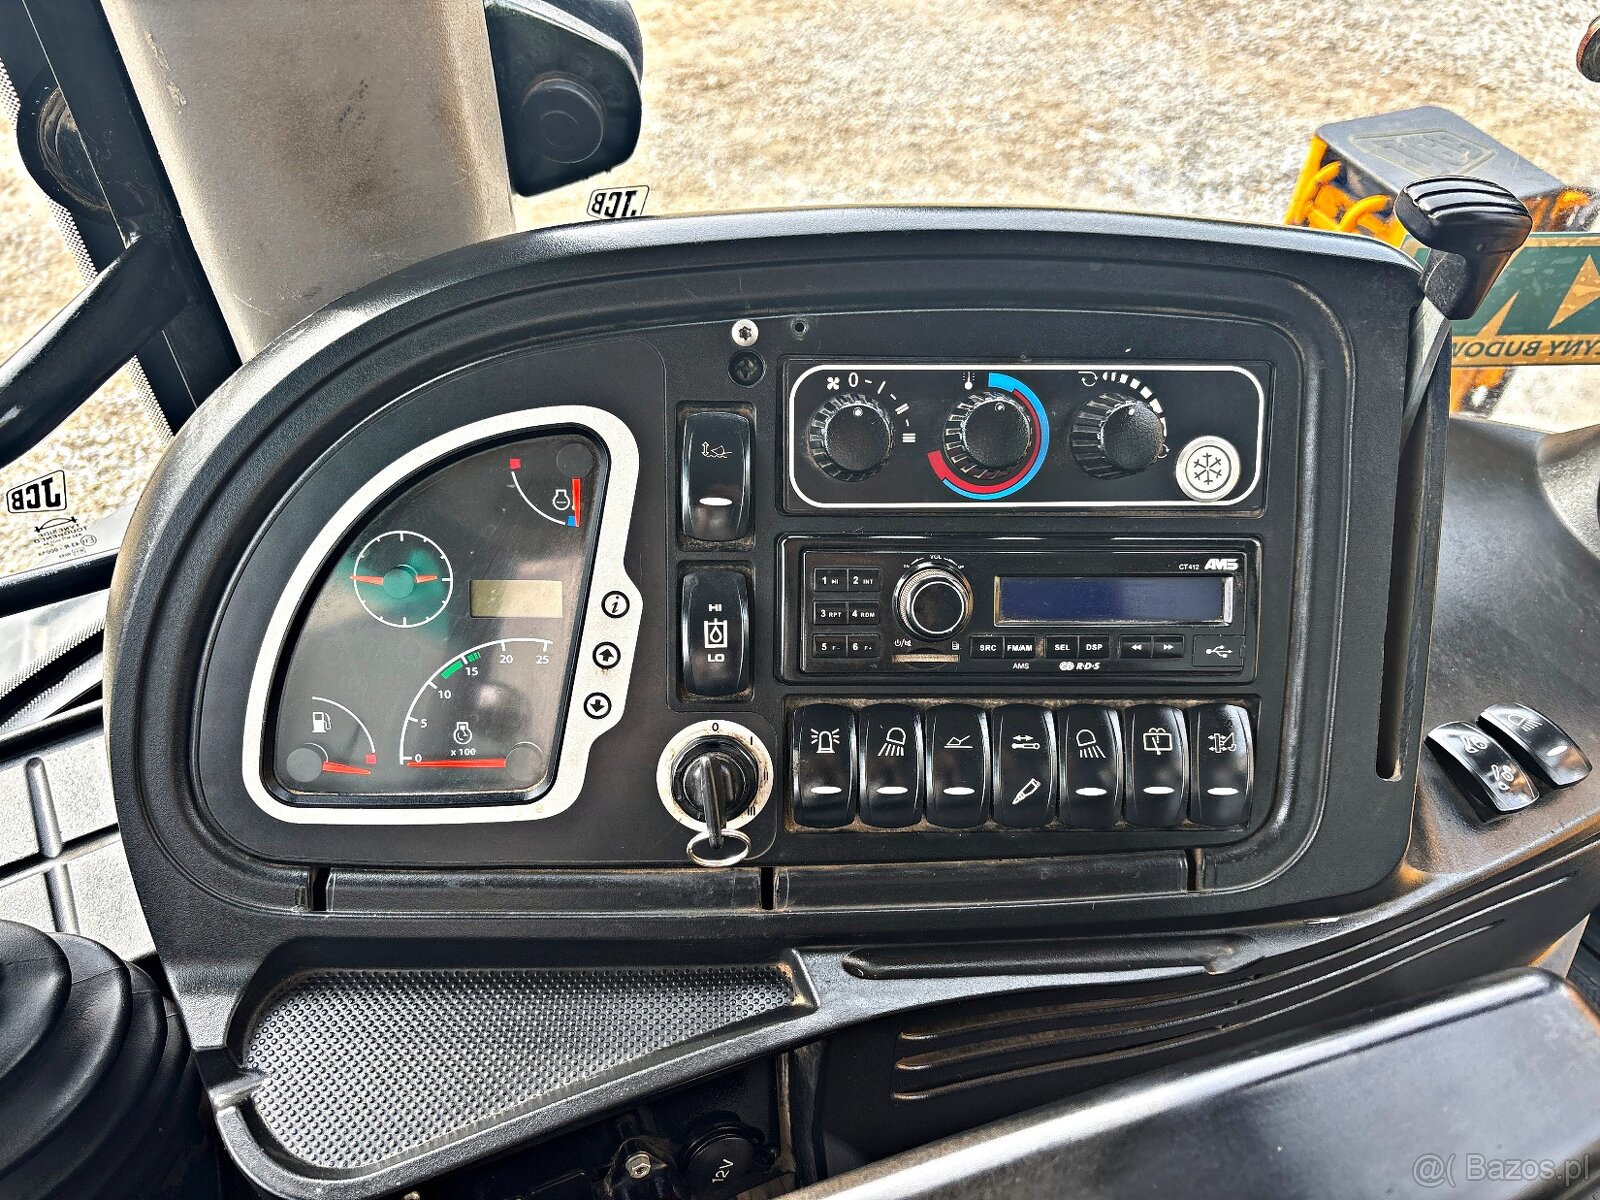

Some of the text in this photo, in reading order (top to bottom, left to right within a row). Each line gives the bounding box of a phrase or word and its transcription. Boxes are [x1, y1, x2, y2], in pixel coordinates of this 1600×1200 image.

[848, 372, 859, 387] 0
[821, 576, 827, 585] 1
[853, 576, 859, 585] 2
[708, 603, 723, 612] HI
[820, 609, 826, 618] 3
[851, 609, 858, 618] 4
[821, 642, 827, 651] 5
[852, 642, 859, 651] 6
[1085, 643, 1103, 651] DSP
[500, 655, 513, 664] 20
[536, 655, 550, 664] 25
[707, 653, 725, 662] LO
[1012, 662, 1030, 670] AMS
[466, 667, 479, 676] 15
[438, 689, 452, 699] 10
[420, 719, 428, 729] 5
[459, 748, 476, 756] 100
[414, 754, 423, 763] 0
[711, 1158, 734, 1184] 12V
